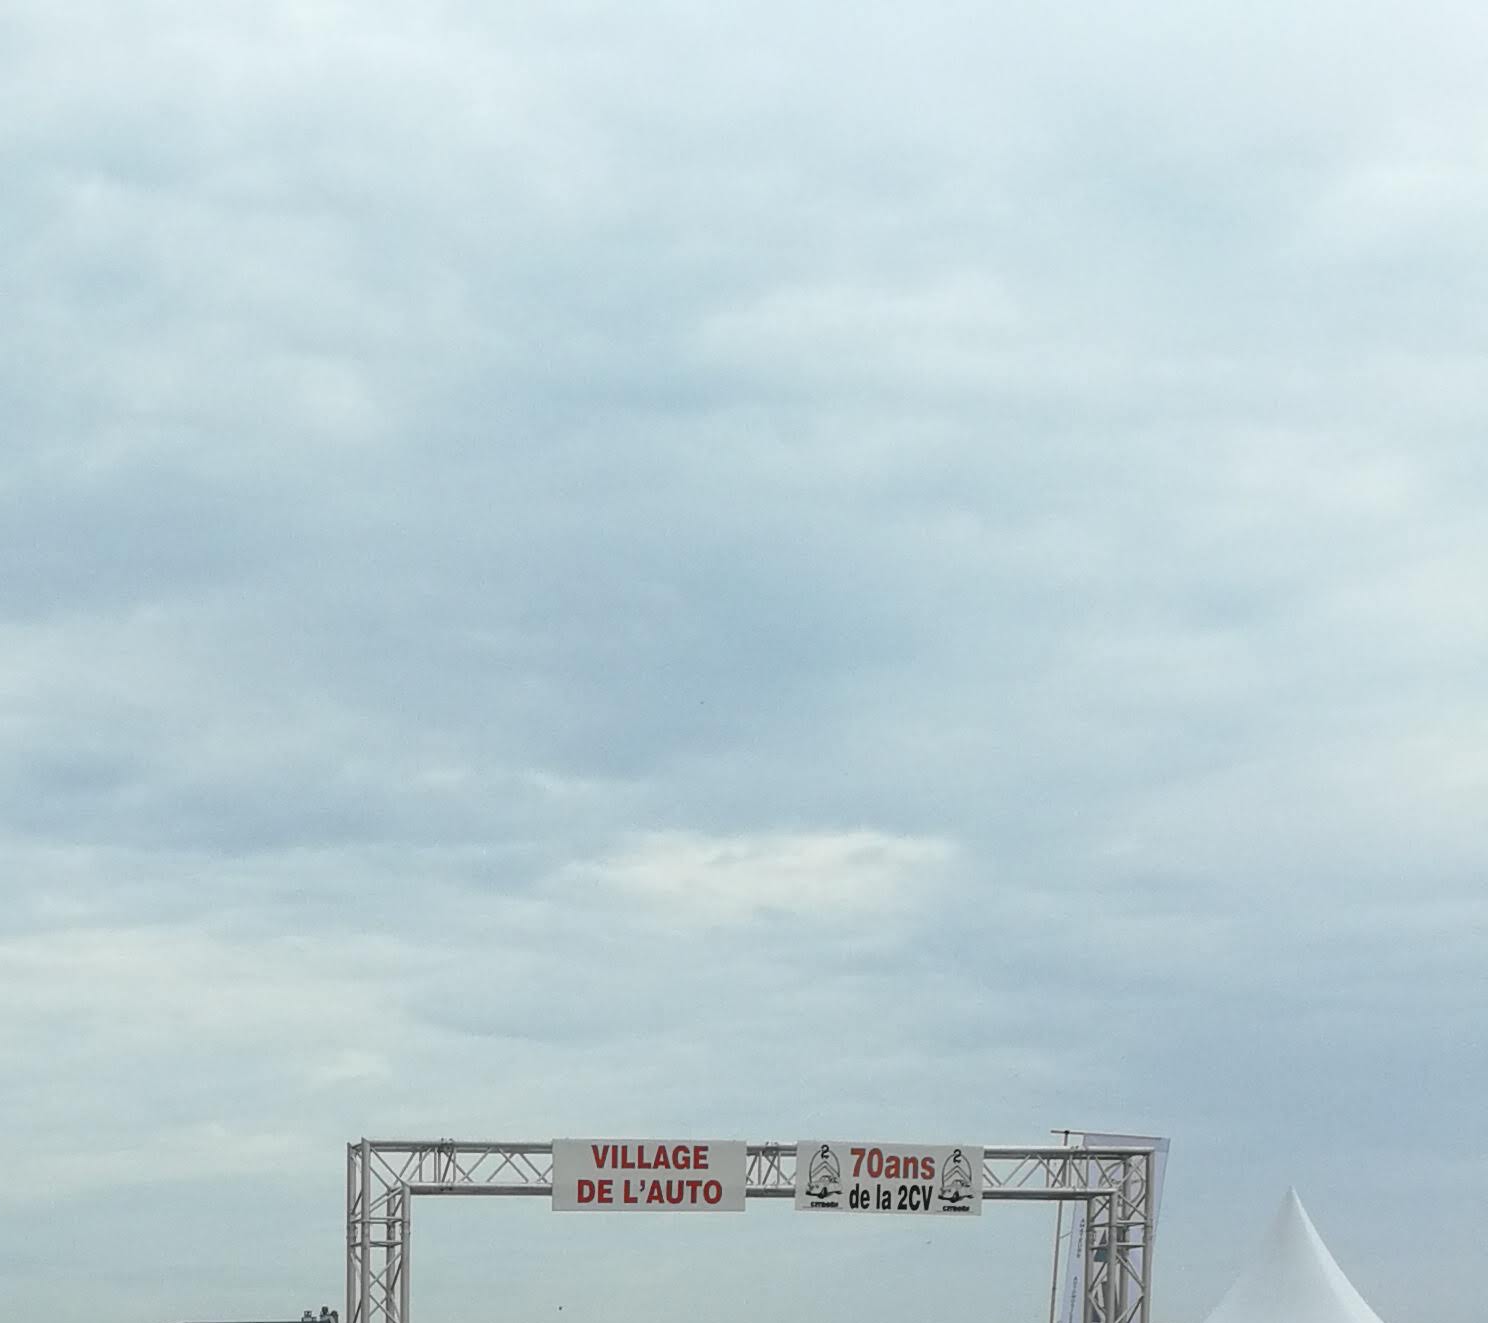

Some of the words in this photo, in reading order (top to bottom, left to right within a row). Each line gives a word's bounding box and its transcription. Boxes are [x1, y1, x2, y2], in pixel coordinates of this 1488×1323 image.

[591, 1144, 710, 1170] VILLAGE
[850, 1147, 936, 1180] 70ans
[577, 1179, 614, 1204] DE
[623, 1179, 723, 1205] L'AUTO
[849, 1183, 870, 1210] de
[876, 1184, 892, 1210] la
[897, 1184, 934, 1211] 2CV
